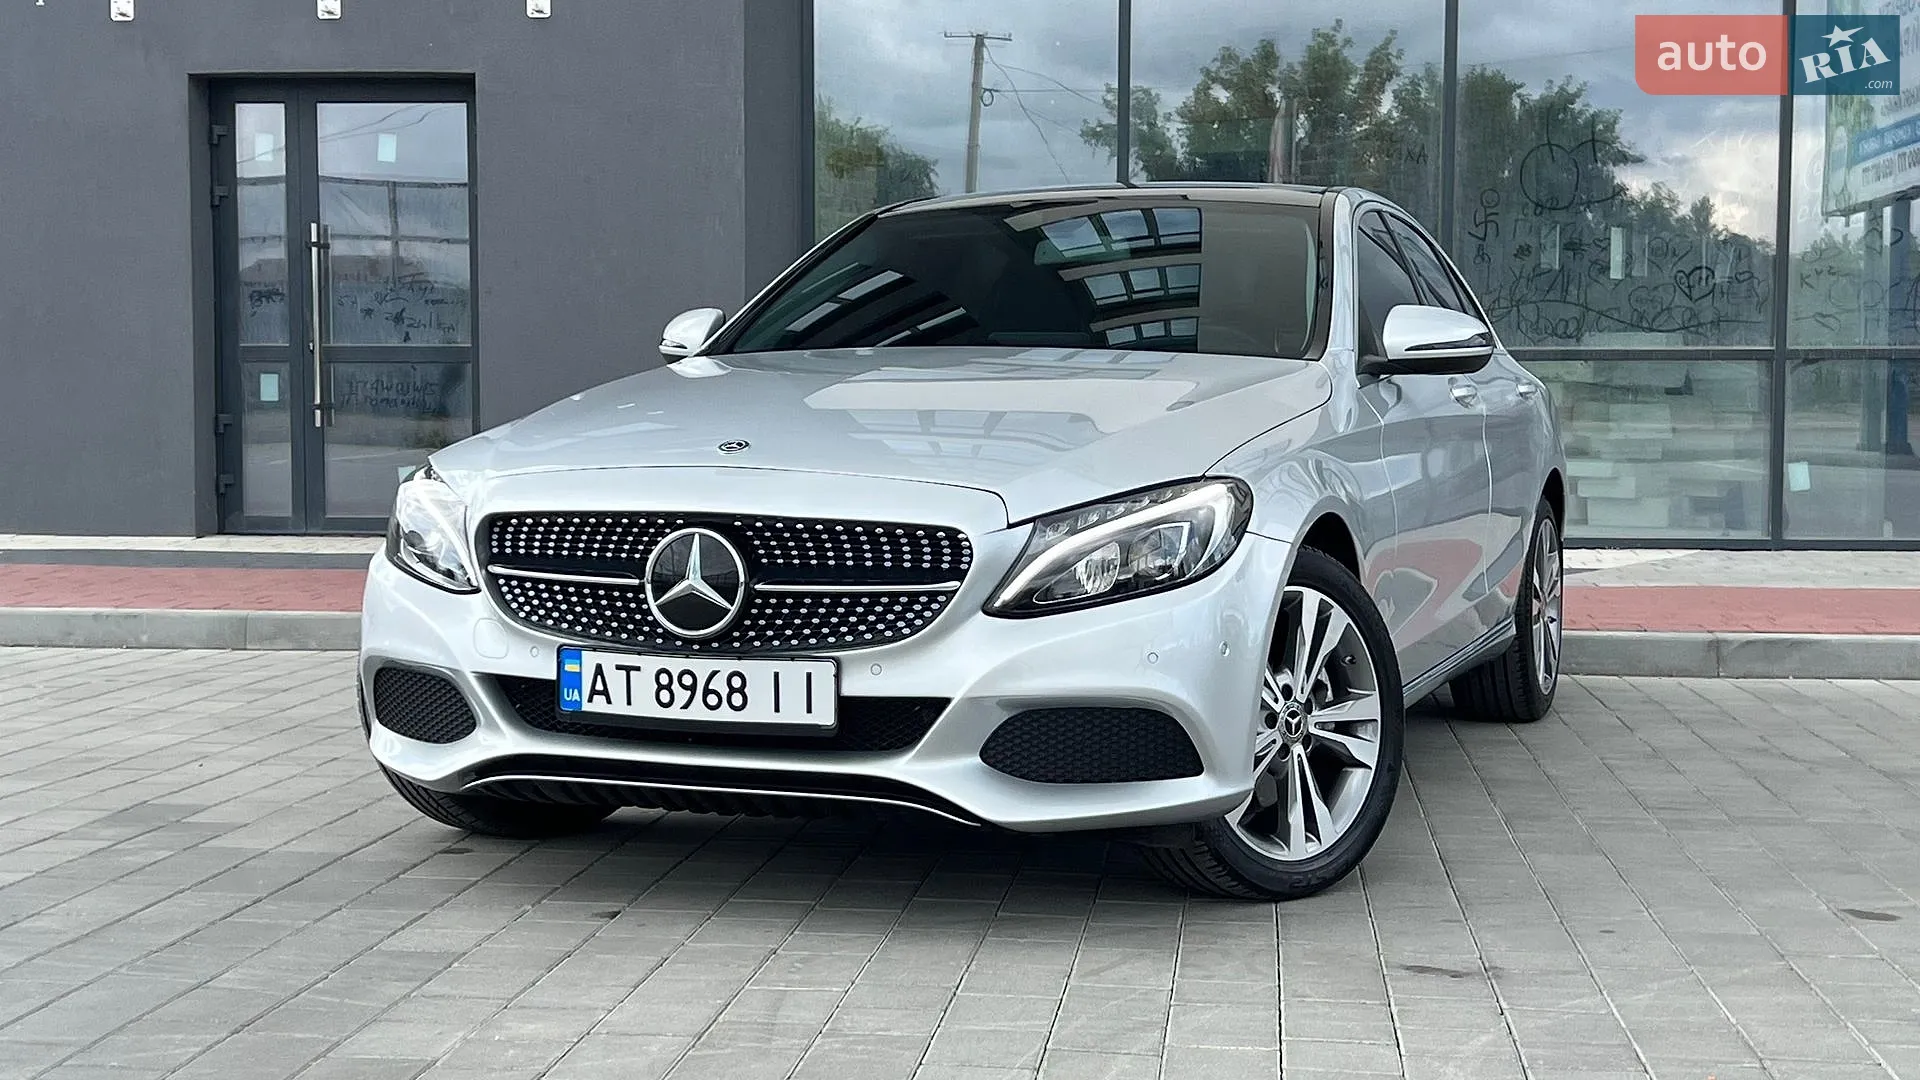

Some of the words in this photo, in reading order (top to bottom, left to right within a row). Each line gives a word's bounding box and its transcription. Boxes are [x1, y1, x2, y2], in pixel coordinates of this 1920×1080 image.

[563, 687, 581, 703] UA
[587, 662, 642, 706] AT
[654, 667, 749, 712] 8968
